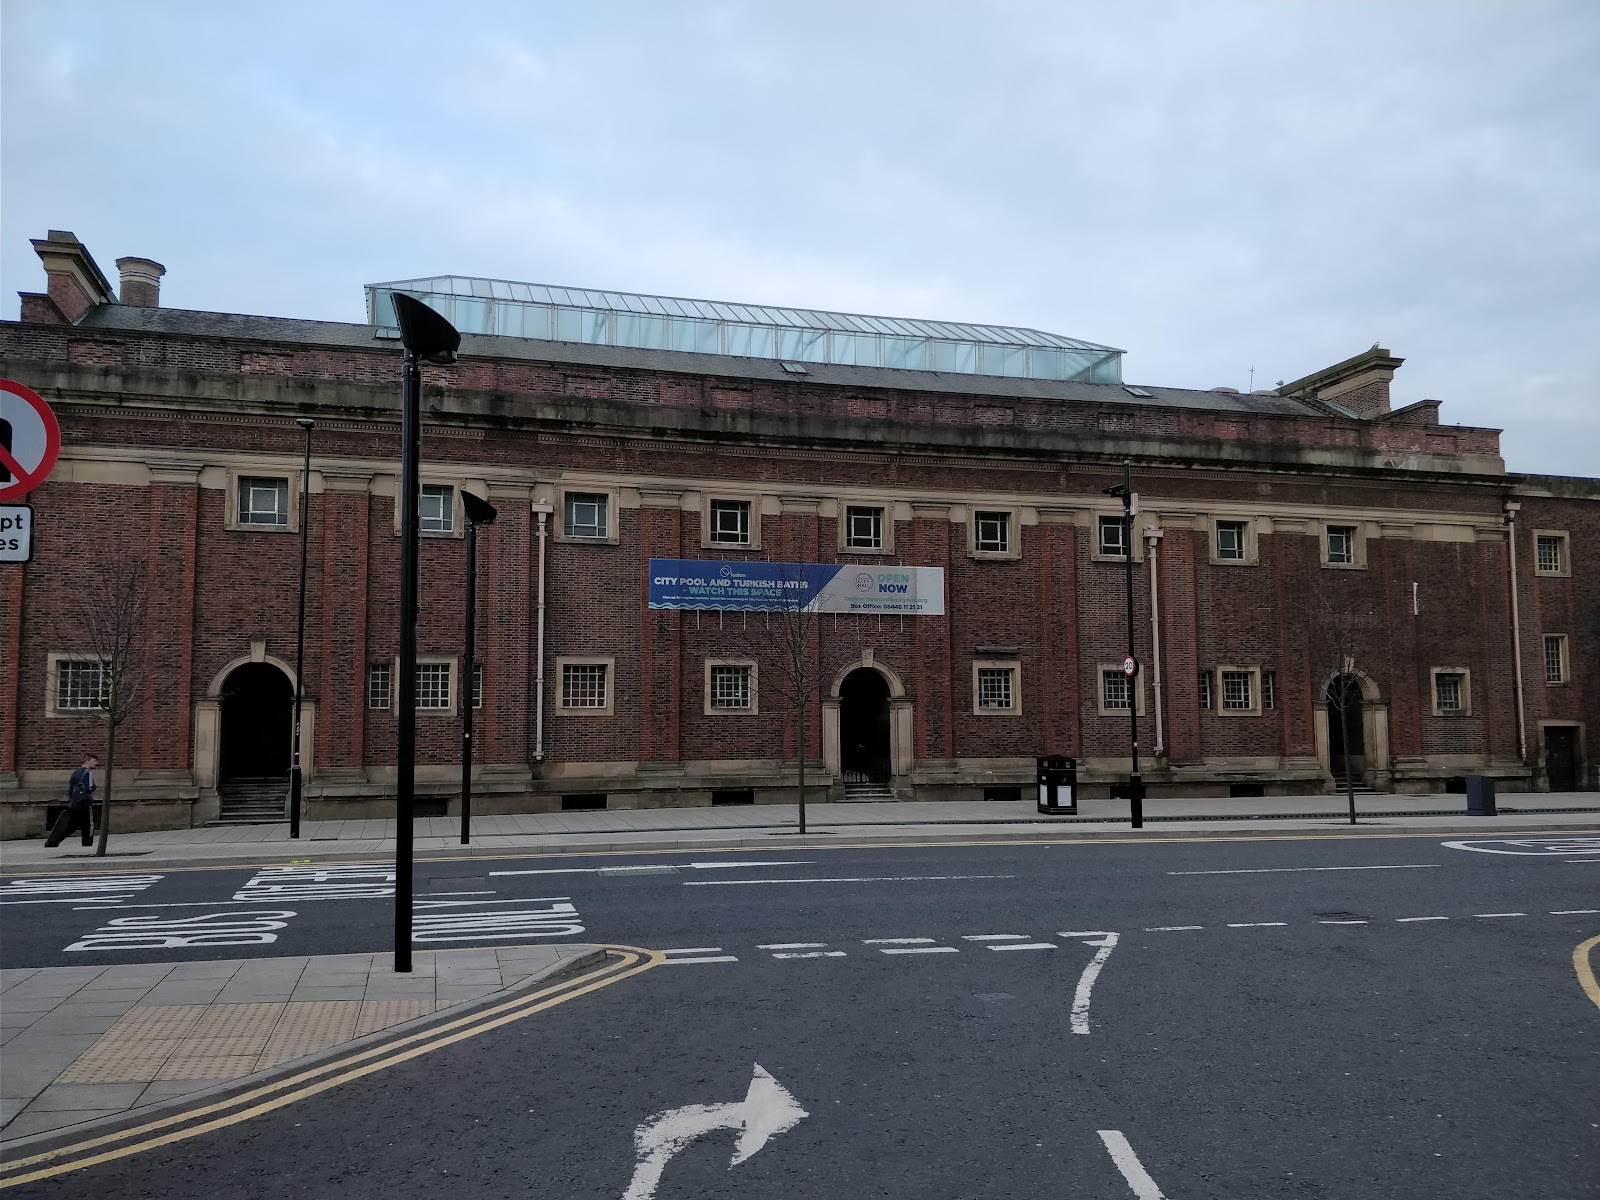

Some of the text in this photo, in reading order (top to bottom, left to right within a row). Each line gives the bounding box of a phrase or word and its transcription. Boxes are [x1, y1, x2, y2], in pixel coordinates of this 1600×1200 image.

[653, 577, 678, 586] CITY
[680, 578, 707, 587] POOL
[709, 579, 731, 587] AND
[733, 579, 775, 588] TURKISH
[877, 573, 909, 583] OPEN
[688, 586, 725, 595] WATCH
[727, 587, 750, 596] THIS
[750, 588, 782, 597] SPACE
[878, 584, 908, 593] NOW
[1125, 661, 1133, 670] 20
[411, 897, 586, 941] ONLY
[62, 910, 298, 951] BUS
